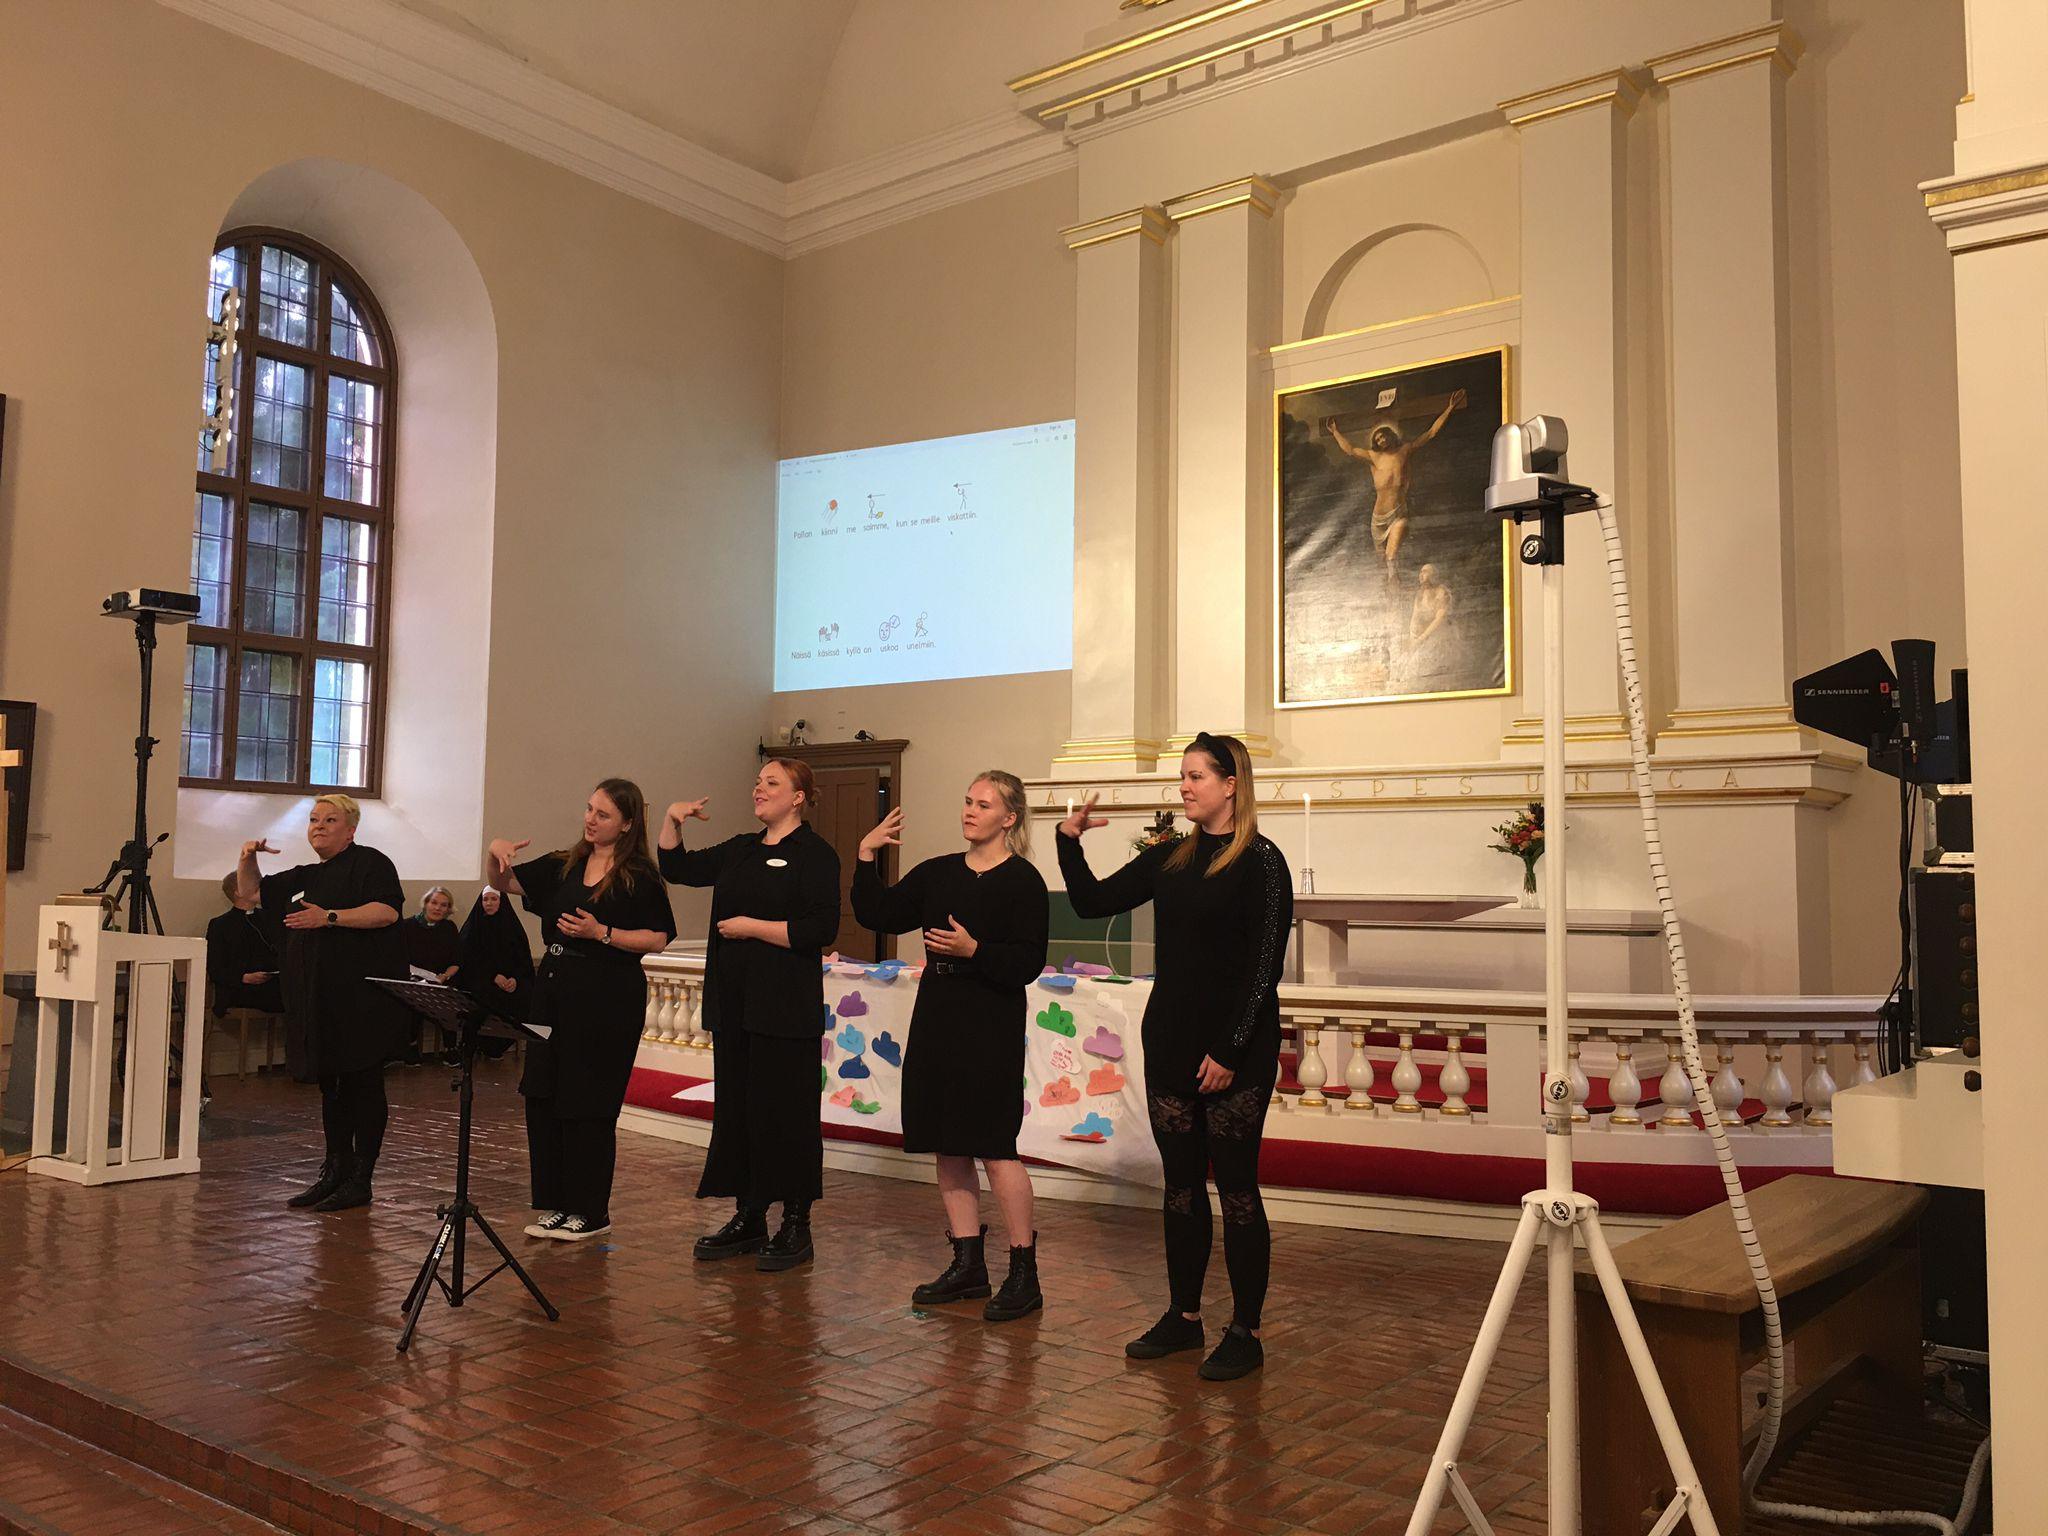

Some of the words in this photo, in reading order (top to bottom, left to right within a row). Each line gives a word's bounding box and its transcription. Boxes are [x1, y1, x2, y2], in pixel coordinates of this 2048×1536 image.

[821, 527, 838, 536] kiinni
[846, 526, 857, 534] me
[895, 519, 908, 528] kun
[910, 518, 918, 527] se
[920, 515, 941, 525] meille
[880, 643, 899, 653] uskoa
[1046, 788, 1123, 805] AVE
[1330, 776, 1472, 799] SPES
[1526, 768, 1739, 793] UNICA
